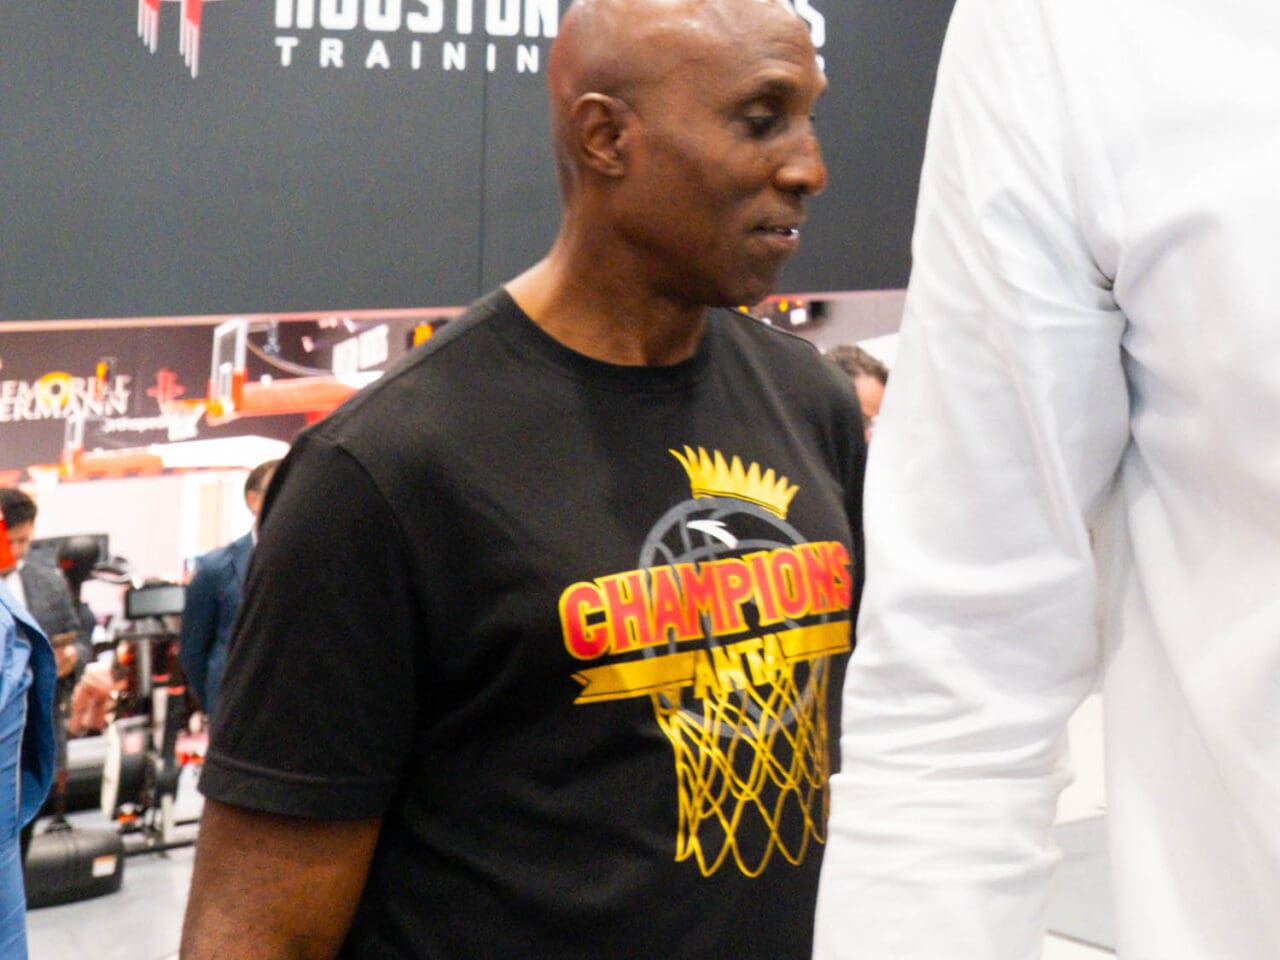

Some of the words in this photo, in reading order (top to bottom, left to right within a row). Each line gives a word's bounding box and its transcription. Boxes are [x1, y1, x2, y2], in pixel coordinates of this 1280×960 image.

[274, 36, 540, 74] TRAININ
[558, 540, 853, 661] CHAMPIONS
[693, 632, 790, 700] ANTA
